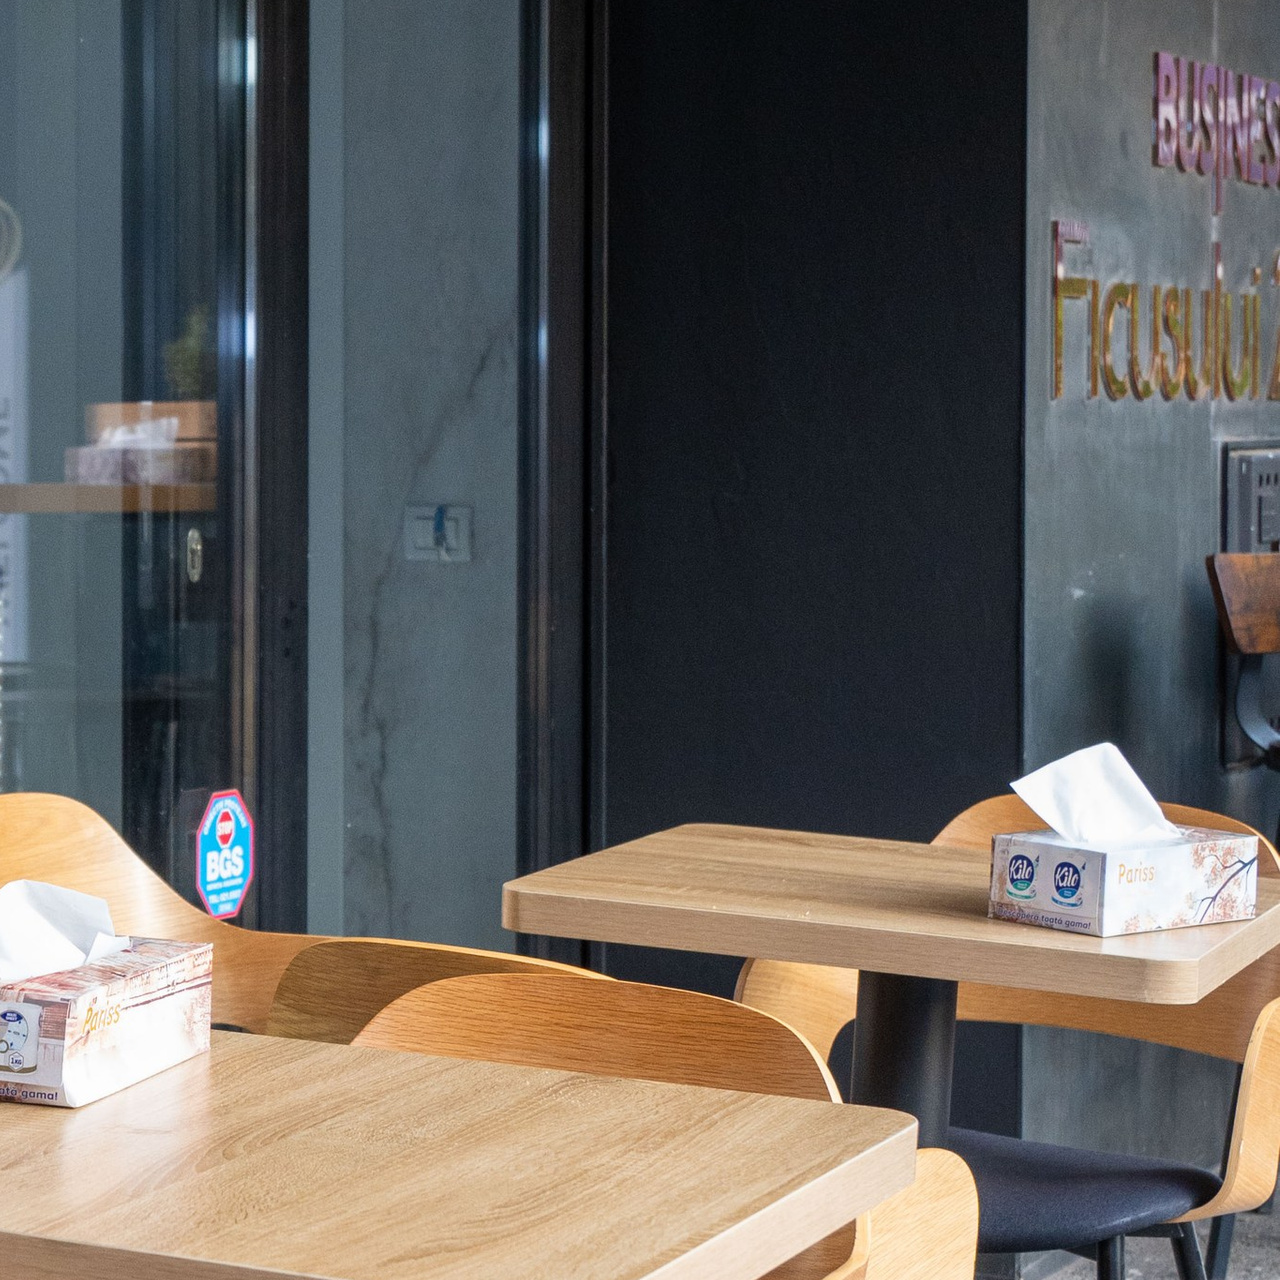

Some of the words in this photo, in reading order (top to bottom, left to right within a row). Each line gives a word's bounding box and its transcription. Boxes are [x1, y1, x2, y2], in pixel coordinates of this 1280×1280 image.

[1051, 220, 1261, 403] Ficusului
[206, 845, 244, 882] BGS
[1009, 859, 1033, 880] Kilo
[1118, 862, 1155, 885] Pariss
[1055, 866, 1079, 887] Kilo
[1064, 919, 1092, 930] gama!
[82, 1000, 121, 1035] Pariss
[21, 1090, 58, 1101] gama!
